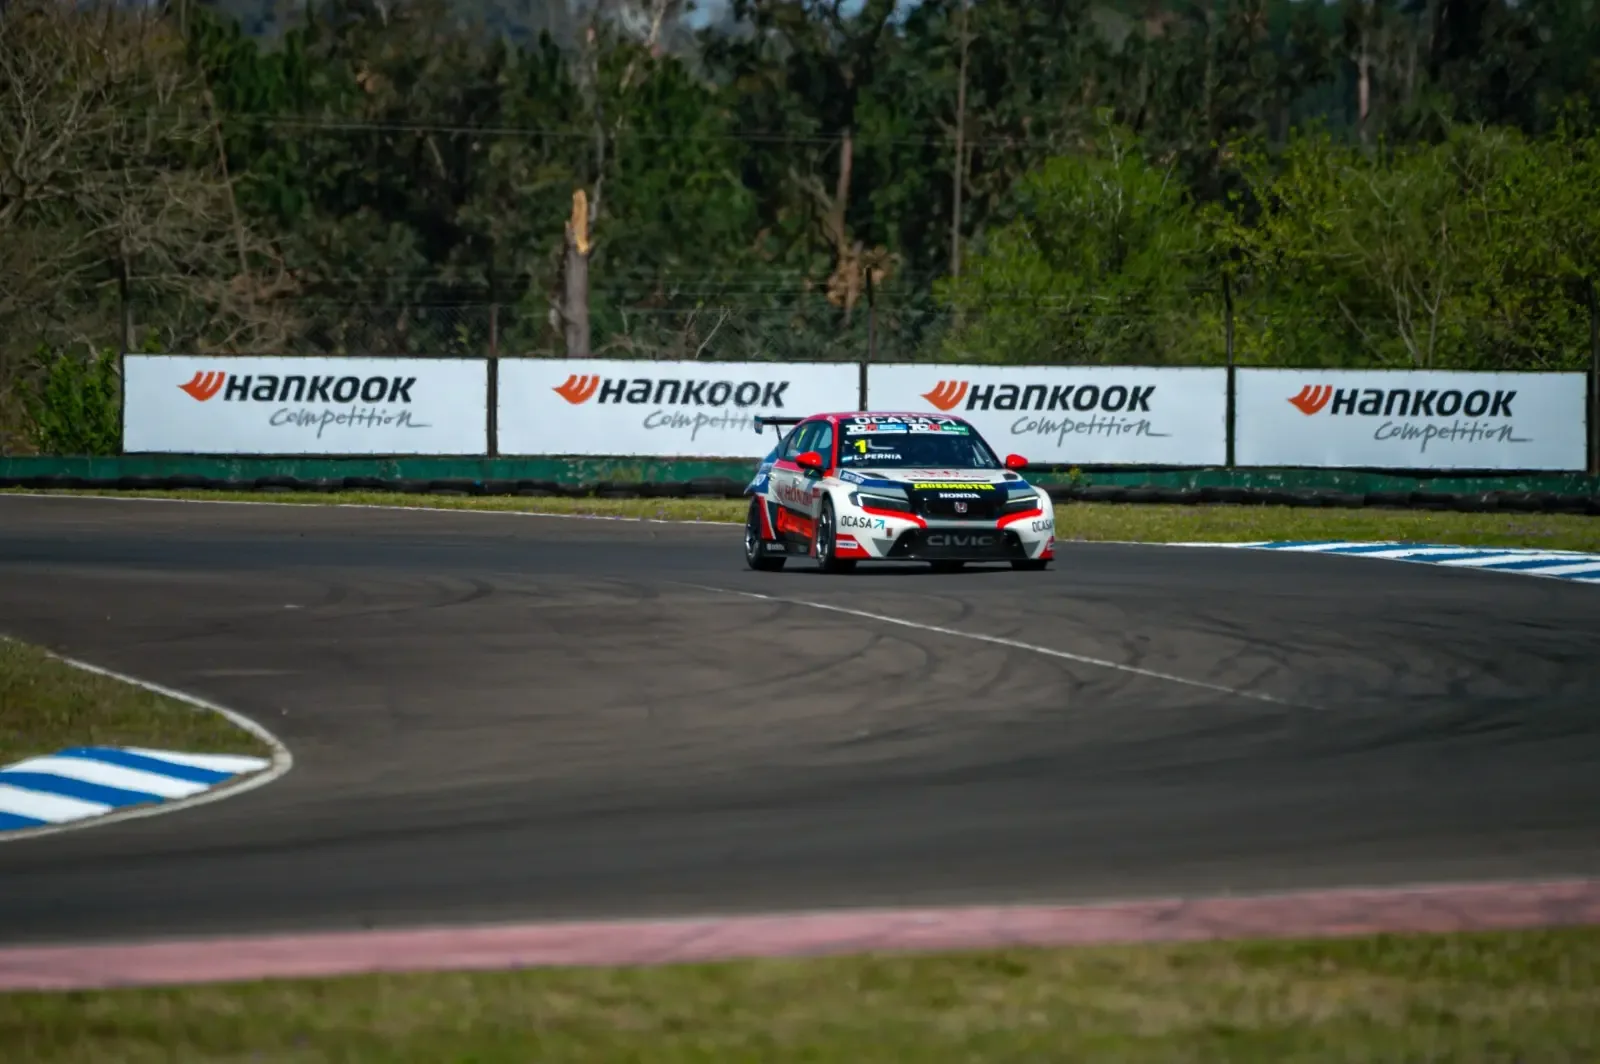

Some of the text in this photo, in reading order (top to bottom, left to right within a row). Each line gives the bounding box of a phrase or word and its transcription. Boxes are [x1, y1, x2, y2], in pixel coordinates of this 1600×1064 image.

[269, 404, 433, 439] Competition
[1010, 413, 1173, 448] Competition
[854, 439, 867, 453] 1
[1373, 418, 1534, 454] Competition
[841, 515, 872, 529] OCASA
[927, 535, 993, 546] CIVIC
